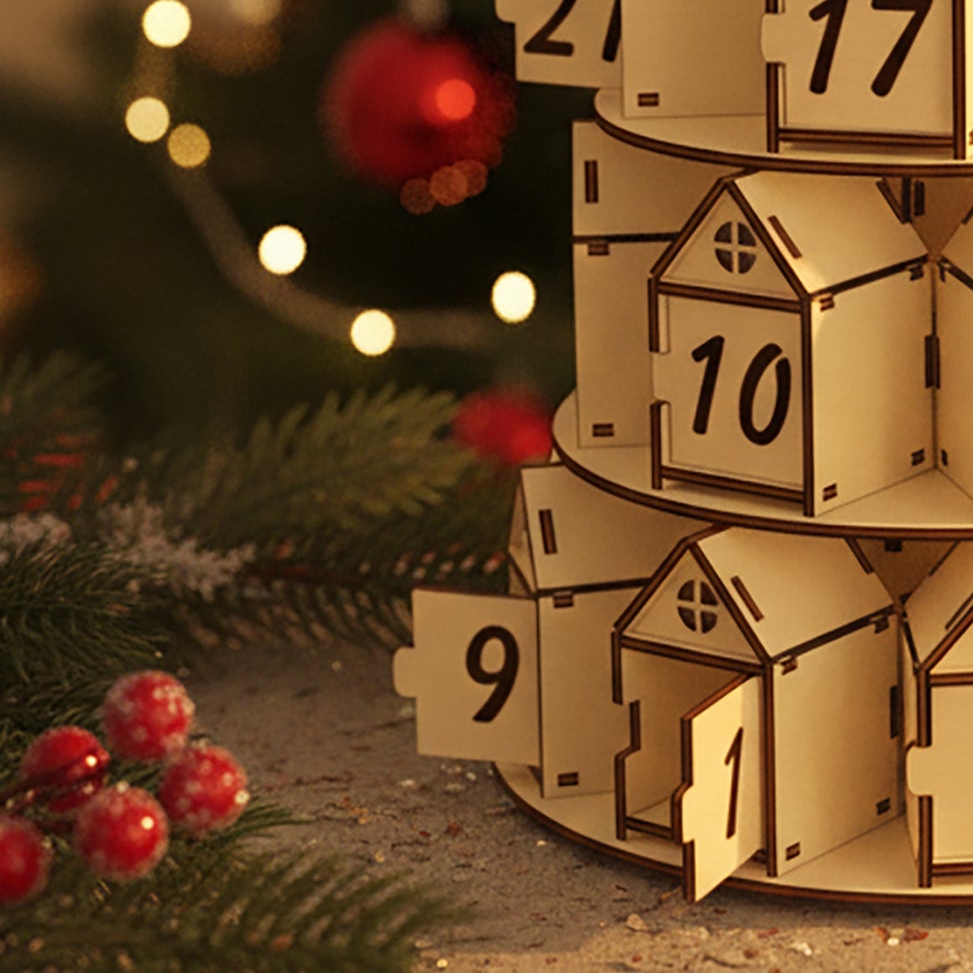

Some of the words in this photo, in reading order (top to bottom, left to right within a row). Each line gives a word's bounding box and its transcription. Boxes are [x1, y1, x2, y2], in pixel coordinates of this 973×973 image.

[691, 334, 792, 447] 10
[465, 624, 521, 724] 9
[723, 727, 744, 838] 1
